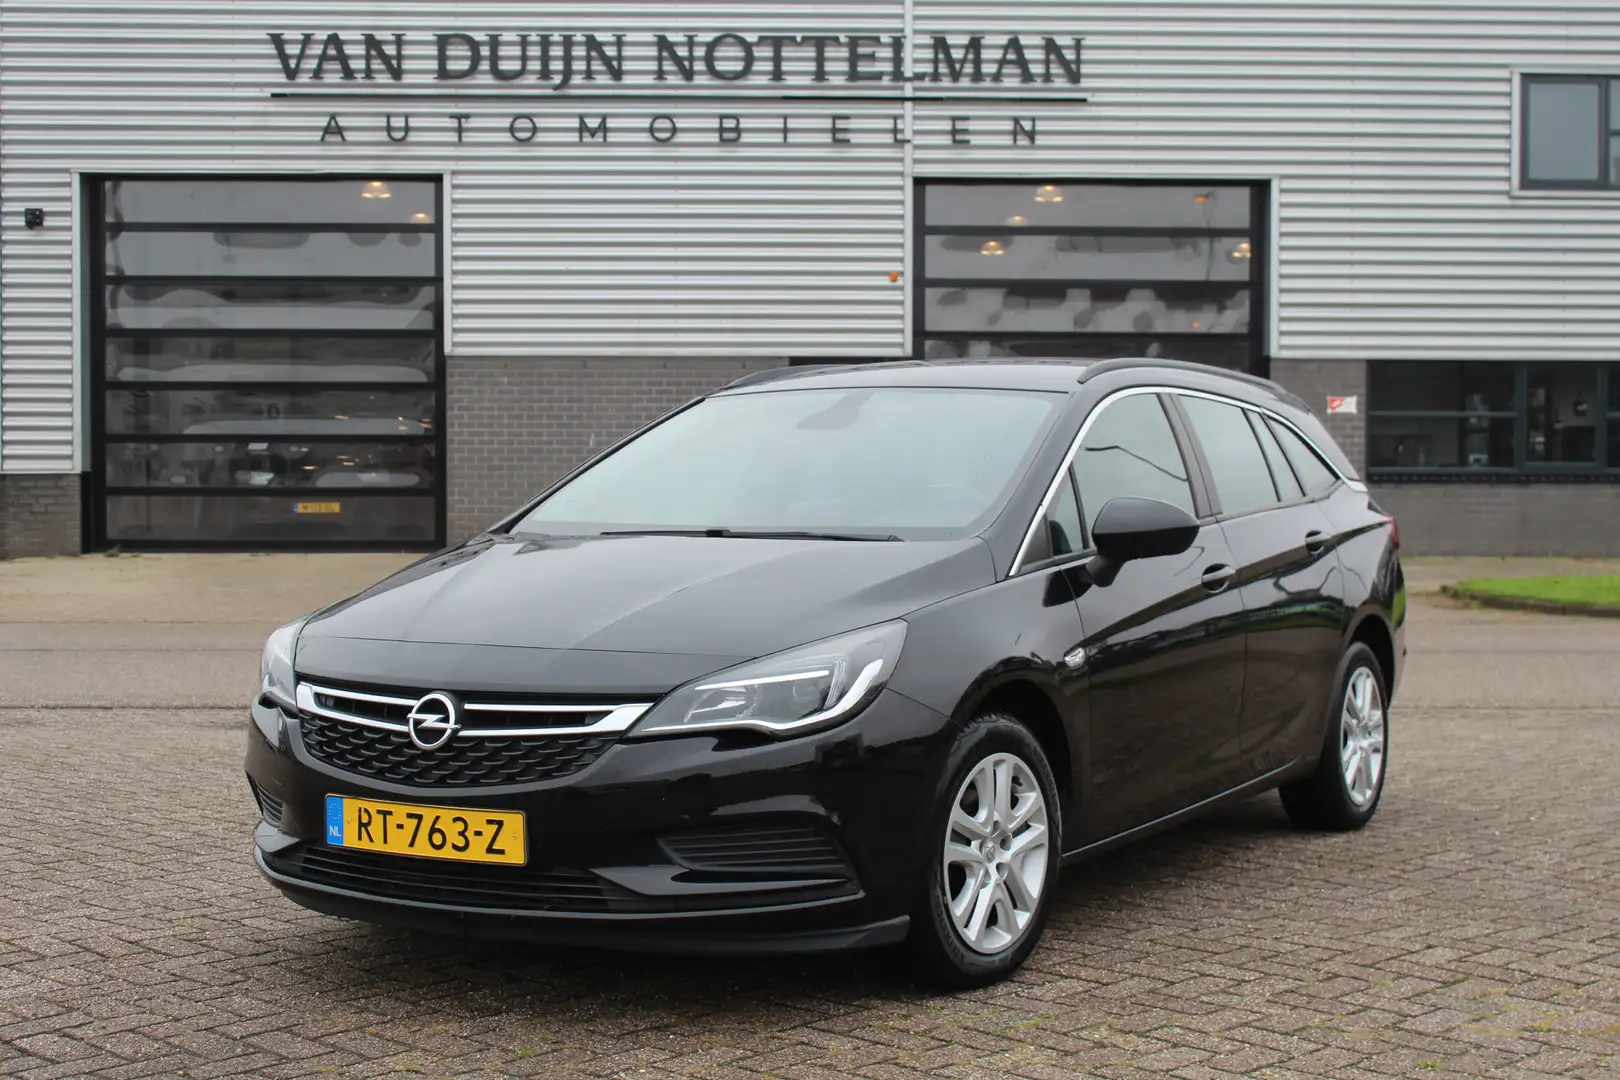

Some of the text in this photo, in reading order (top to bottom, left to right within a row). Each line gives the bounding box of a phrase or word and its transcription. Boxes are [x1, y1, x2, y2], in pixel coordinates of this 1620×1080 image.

[266, 32, 1086, 92] VAN DUIJN NOTTELMAN
[319, 113, 1037, 145] AUTOMOBIELEN
[329, 825, 342, 837] NL
[357, 806, 506, 855] RT-763-Z
